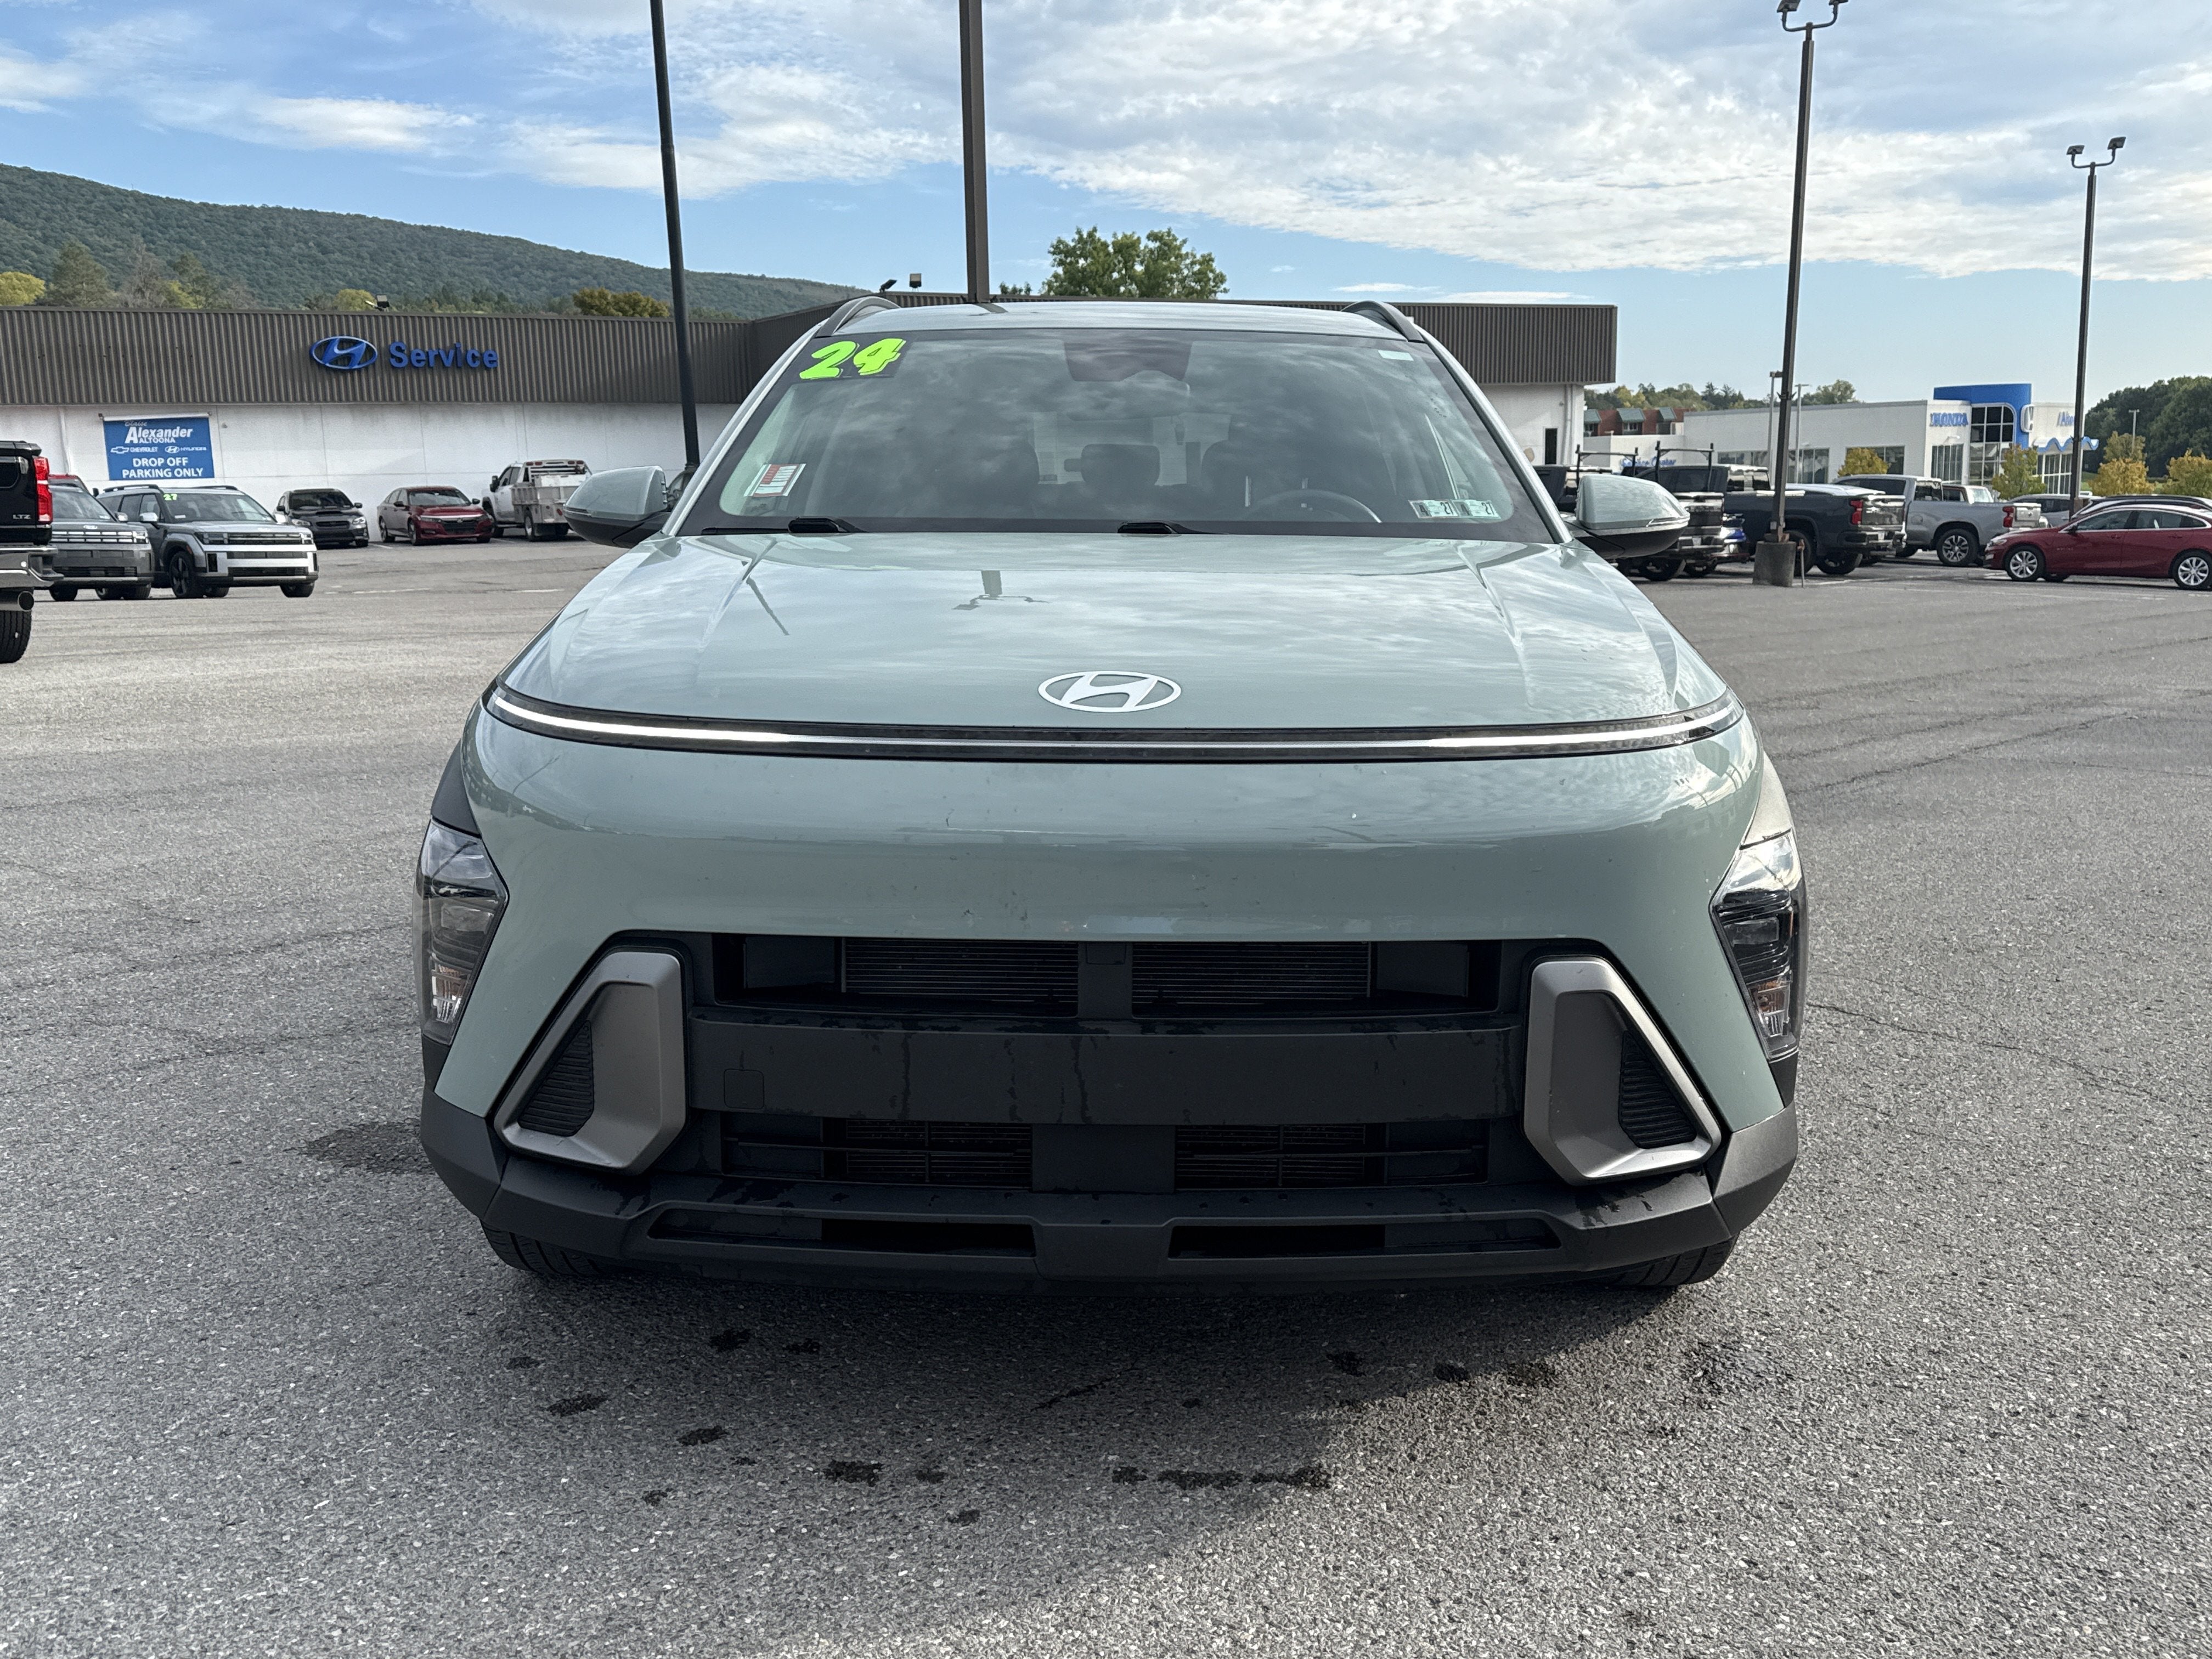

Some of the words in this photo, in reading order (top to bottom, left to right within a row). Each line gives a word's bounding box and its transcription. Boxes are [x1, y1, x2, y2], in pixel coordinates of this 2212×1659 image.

[389, 341, 499, 368] Service
[799, 338, 907, 380] 24
[125, 426, 193, 444] Alexander
[133, 458, 165, 467] DROP
[167, 457, 188, 466] OFF
[122, 469, 172, 478] PARKING
[174, 467, 204, 477] ONLY
[1419, 504, 1429, 516] 4
[1440, 501, 1454, 515] 27
[1460, 504, 1470, 516] 4
[1481, 501, 1495, 516] 27
